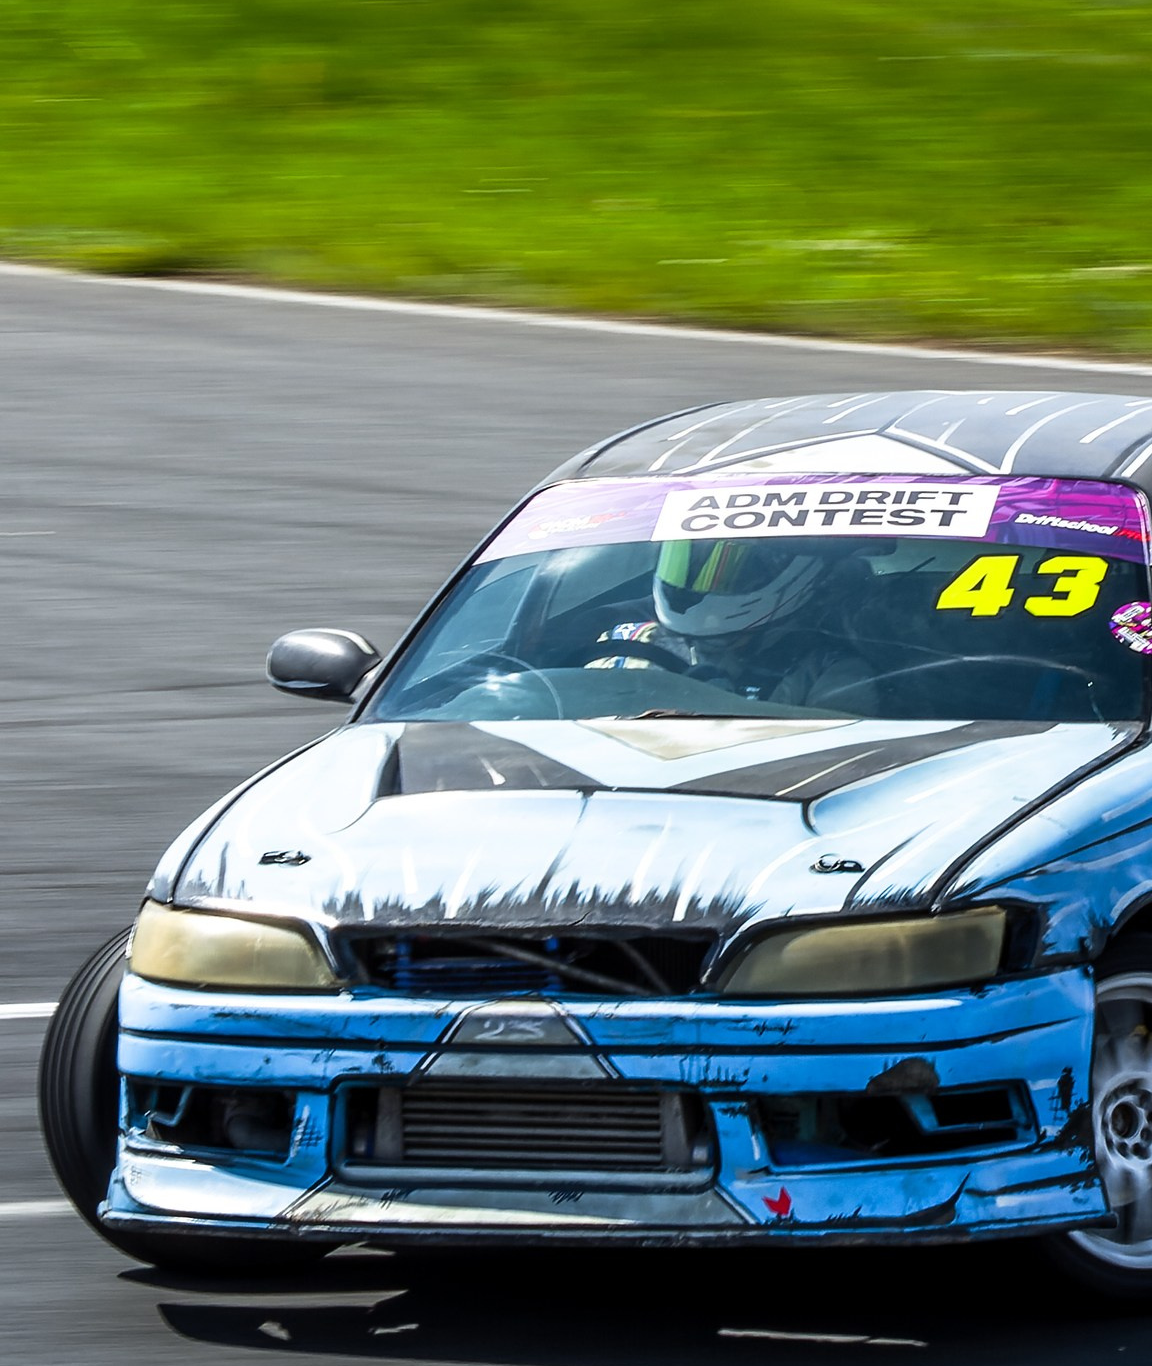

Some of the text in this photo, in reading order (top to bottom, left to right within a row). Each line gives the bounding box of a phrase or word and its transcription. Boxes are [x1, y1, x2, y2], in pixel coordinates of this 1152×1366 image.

[687, 490, 974, 511] ADM DRIFT
[680, 509, 968, 532] CONTEST
[1014, 513, 1119, 536] Driftschool
[935, 555, 1109, 617] 43
